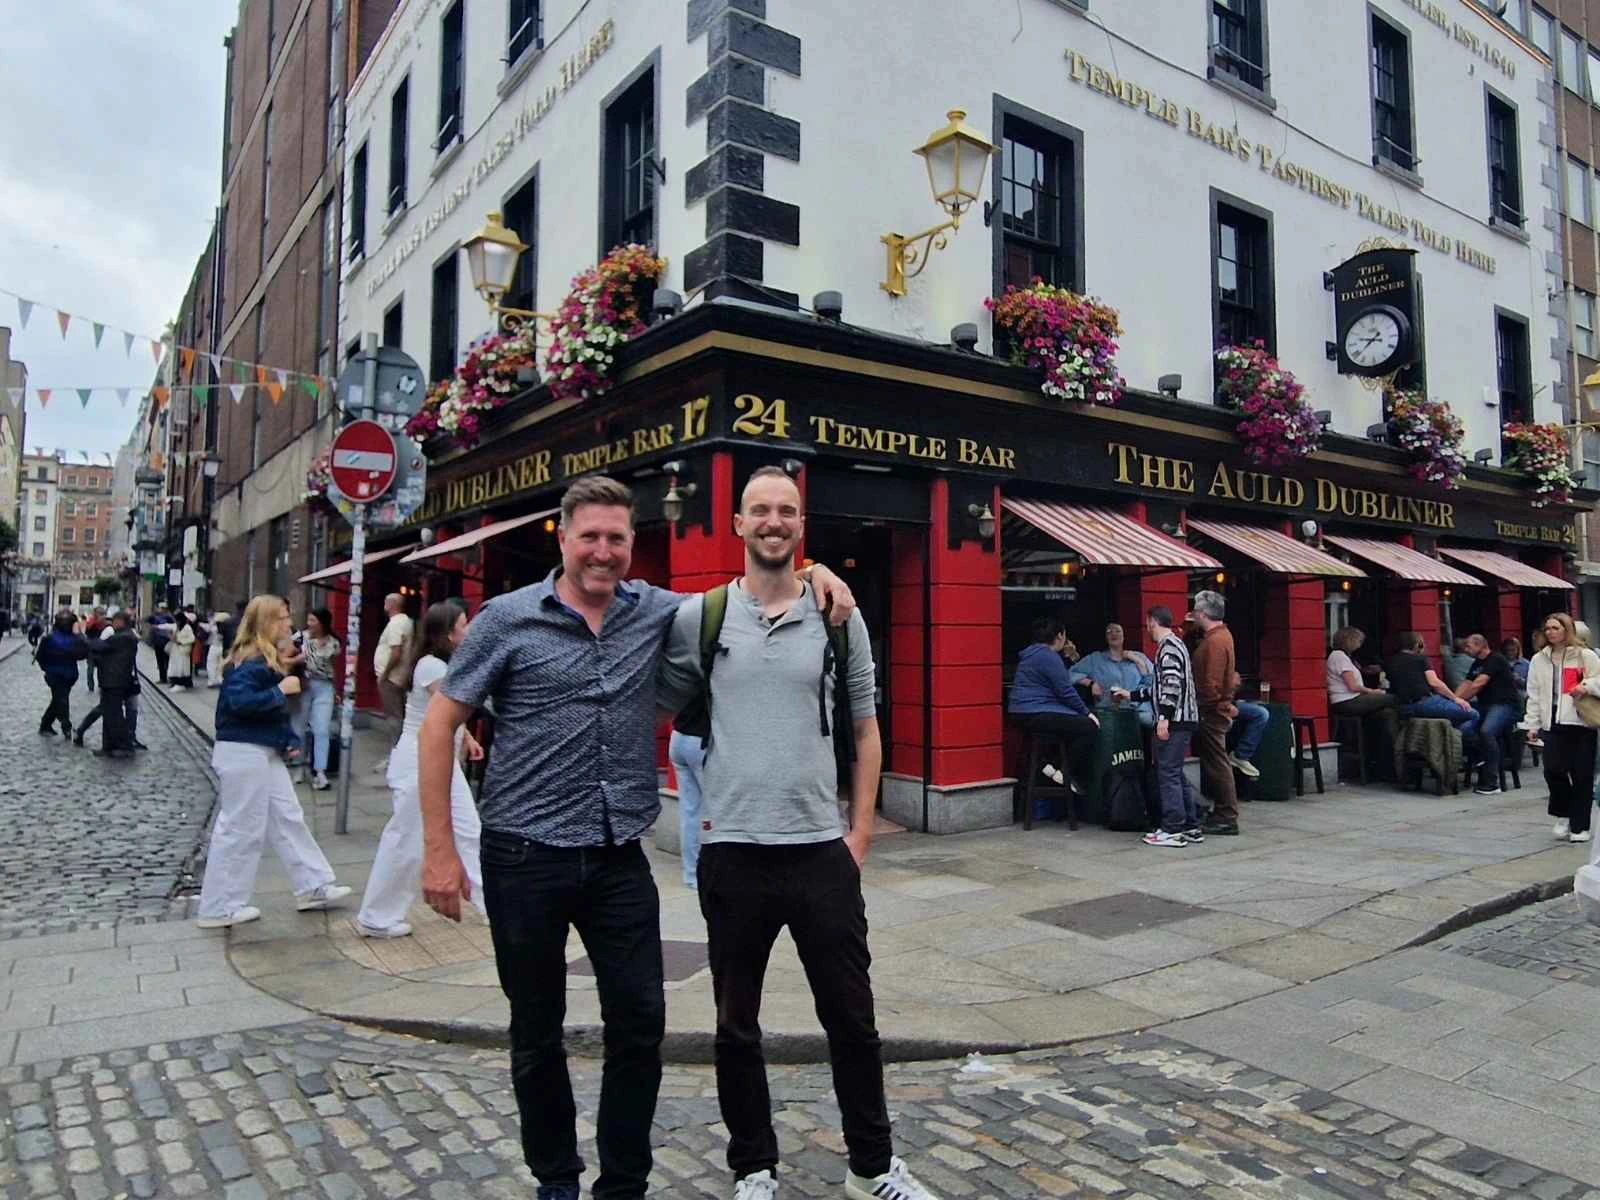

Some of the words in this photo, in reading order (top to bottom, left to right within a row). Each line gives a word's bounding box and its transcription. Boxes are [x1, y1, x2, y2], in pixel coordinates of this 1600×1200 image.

[1064, 48, 1179, 128] TEMPLE
[1186, 105, 1250, 161] BAR'S
[1256, 143, 1351, 209] TASTIEST
[1355, 191, 1408, 235] TALES
[1411, 218, 1450, 255] TOLD
[1456, 239, 1497, 275] HERE
[1341, 280, 1405, 302] DUBLINER
[1355, 273, 1389, 288] AULD
[1358, 263, 1385, 276] THE
[447, 449, 551, 513] DUBLINER
[562, 446, 628, 477] TEMPLE
[633, 423, 674, 458] BAR
[680, 395, 710, 443] 17
[733, 393, 791, 439] 24
[809, 414, 947, 461] TEMPLE
[957, 437, 1017, 470] BAR
[1108, 442, 1195, 493] THE
[1208, 462, 1305, 508] AULD
[1315, 478, 1455, 529] DUBLINER
[1493, 519, 1538, 539] TEMPLE
